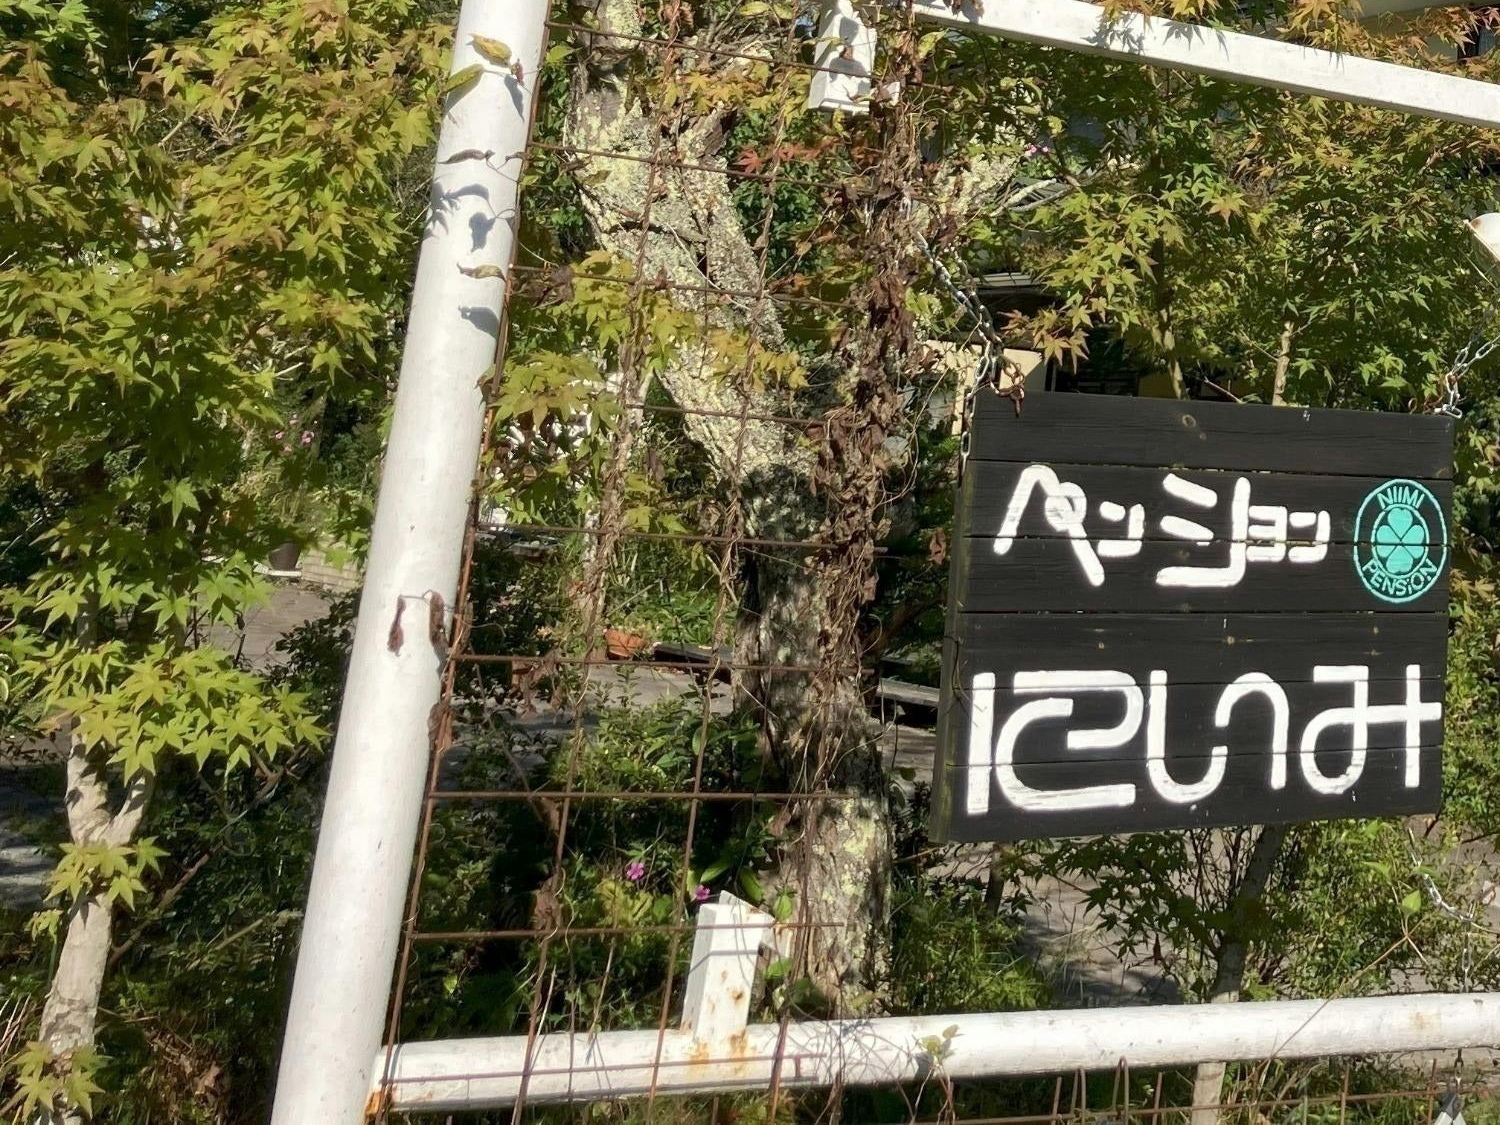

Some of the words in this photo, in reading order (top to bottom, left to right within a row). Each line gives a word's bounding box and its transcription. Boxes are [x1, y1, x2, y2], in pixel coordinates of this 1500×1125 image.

[993, 464, 1331, 587] ペンション
[1377, 486, 1425, 509] NIIMI
[966, 664, 1442, 815] にいみ
